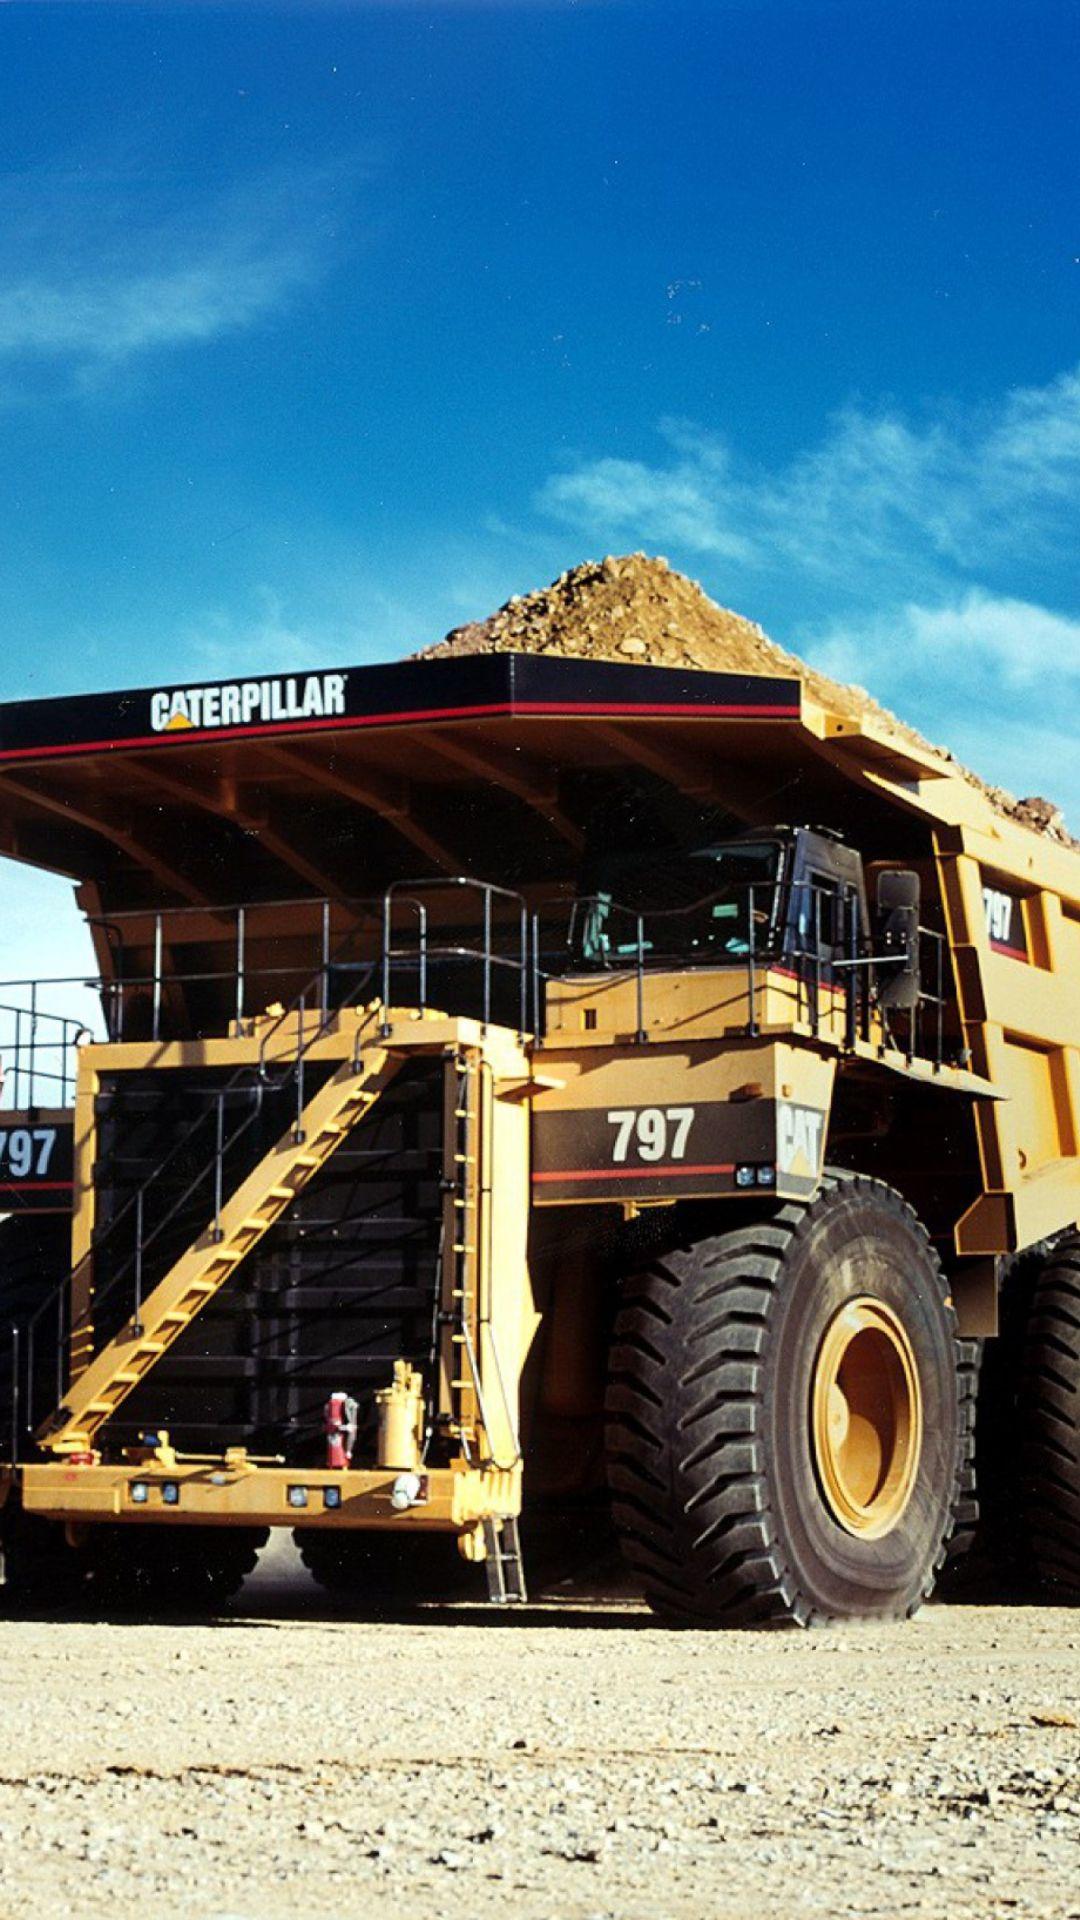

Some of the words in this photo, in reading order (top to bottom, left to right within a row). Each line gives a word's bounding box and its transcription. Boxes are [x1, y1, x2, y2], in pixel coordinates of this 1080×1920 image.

[151, 674, 345, 732] CATERPILLAR
[982, 887, 1012, 941] 797
[607, 1107, 695, 1162] 797
[776, 1103, 824, 1178] CAT
